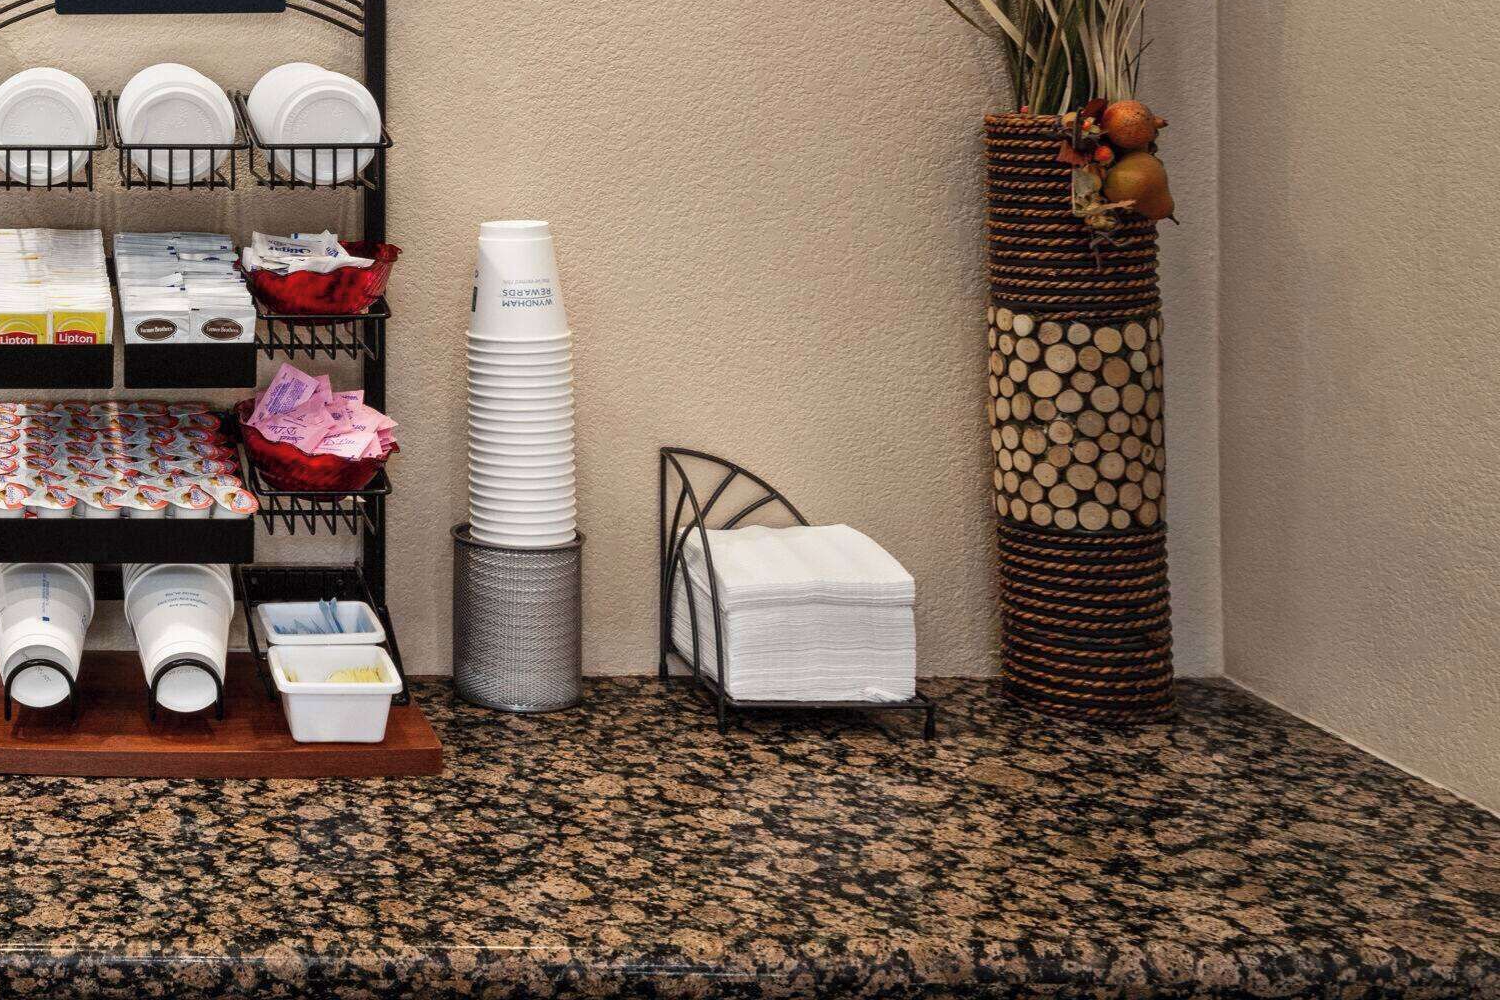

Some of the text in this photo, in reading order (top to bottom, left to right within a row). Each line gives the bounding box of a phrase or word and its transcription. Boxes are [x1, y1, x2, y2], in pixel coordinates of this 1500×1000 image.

[502, 287, 552, 297] REWARDS
[501, 298, 553, 308] WYNDHAM
[59, 333, 94, 344] Lipton
